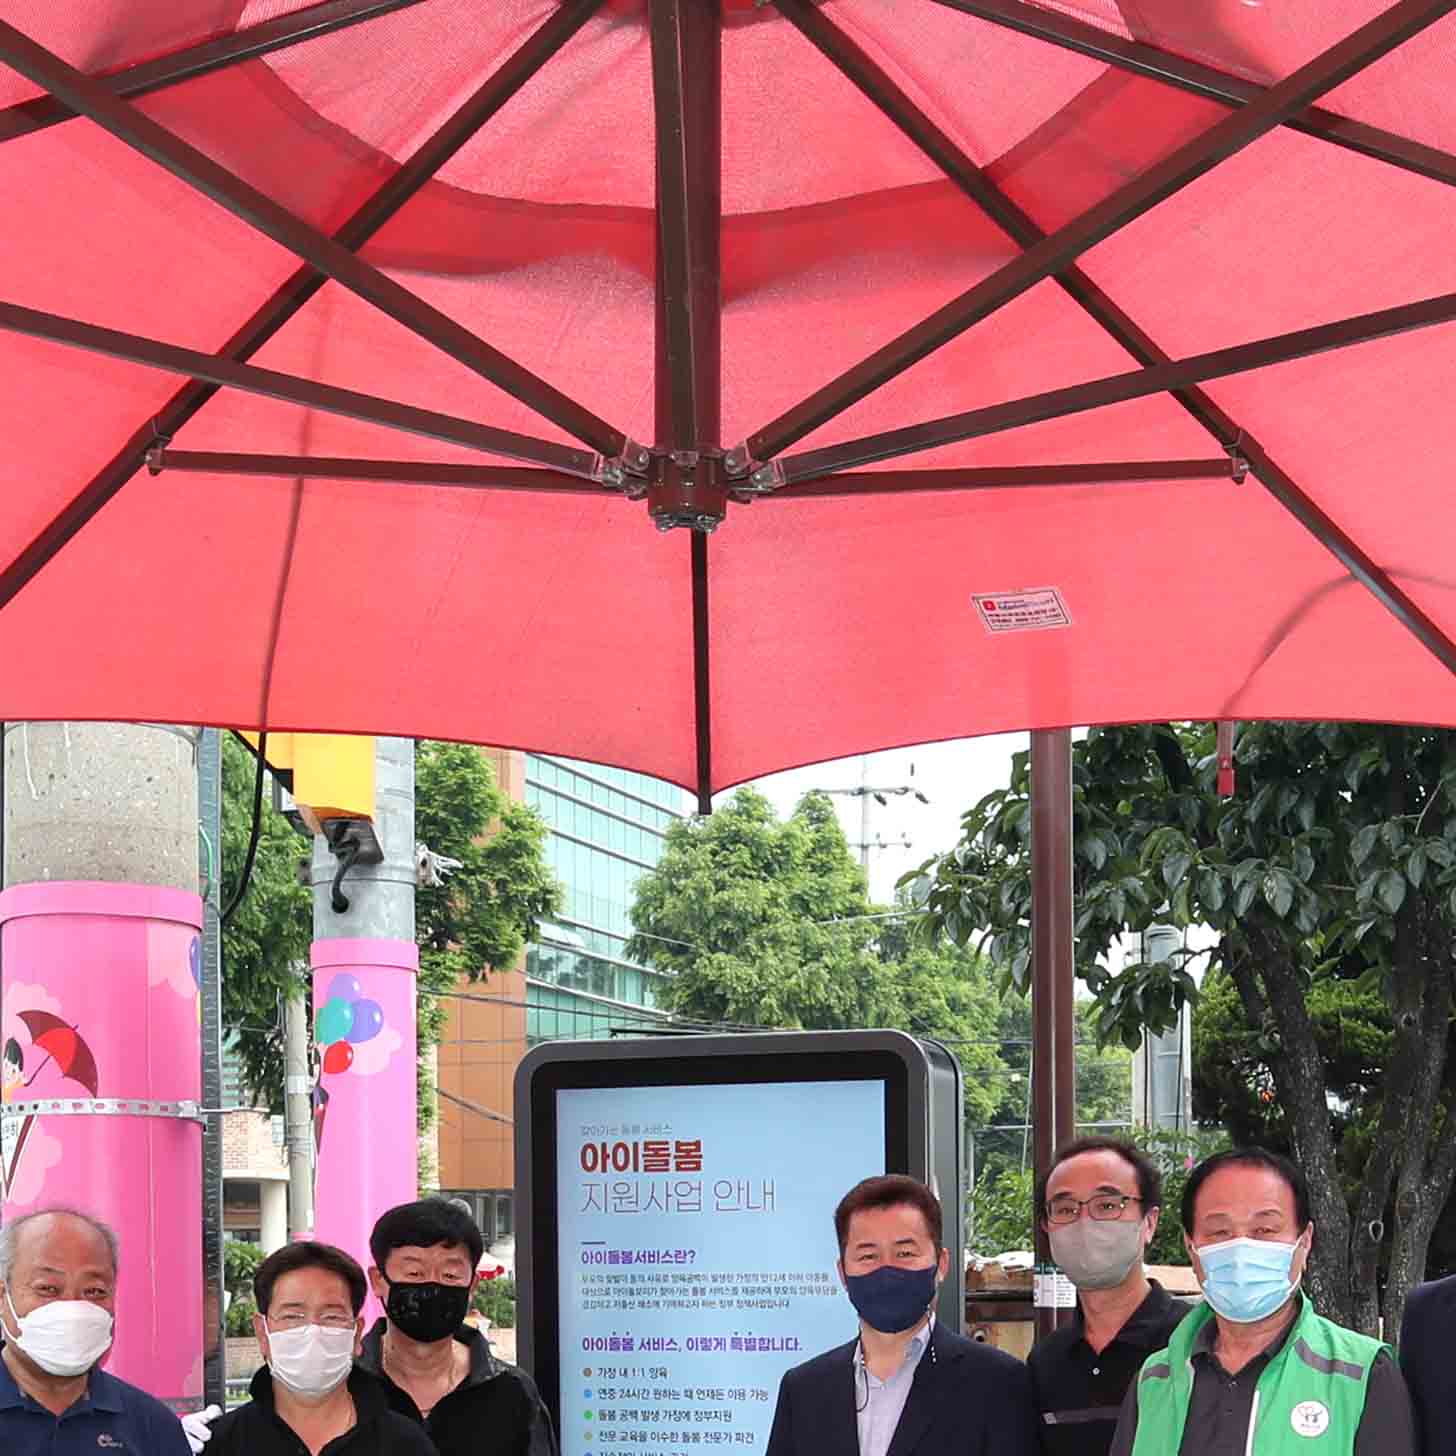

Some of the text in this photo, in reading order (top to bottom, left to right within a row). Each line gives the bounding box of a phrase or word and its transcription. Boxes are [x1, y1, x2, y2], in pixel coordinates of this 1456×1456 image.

[580, 1140, 704, 1173] 아이돌봄
[581, 1176, 776, 1214] 지원사업 안내
[581, 1250, 696, 1265] 아이돌봄서비스란?
[582, 1336, 634, 1352] 아이돌봄
[686, 1336, 727, 1352] 이렇게
[730, 1336, 803, 1352] 특별합니다.
